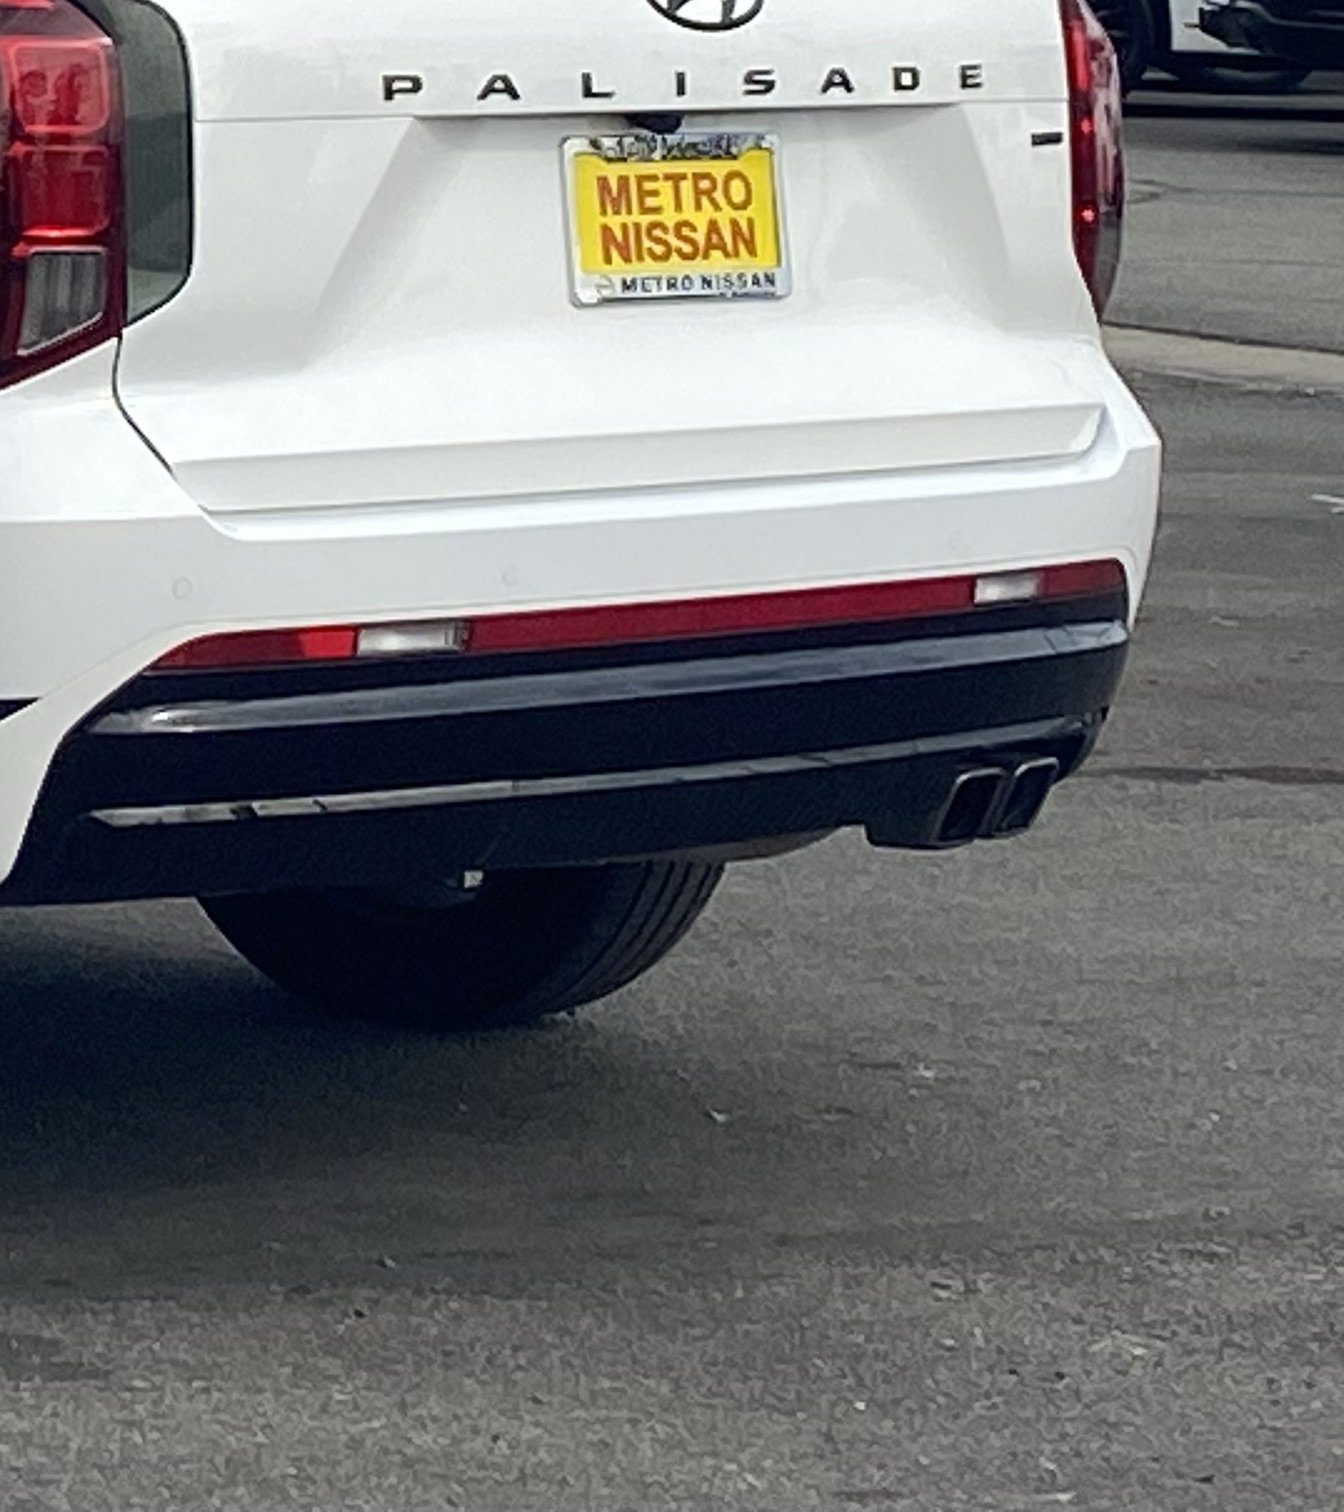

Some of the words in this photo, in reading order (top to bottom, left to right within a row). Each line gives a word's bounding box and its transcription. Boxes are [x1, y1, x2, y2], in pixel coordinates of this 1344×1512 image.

[382, 63, 985, 102] PALISADE
[596, 170, 753, 216] METRO
[599, 217, 758, 266] NISSAN
[620, 274, 694, 293] METRO
[700, 272, 776, 290] NISSAN
